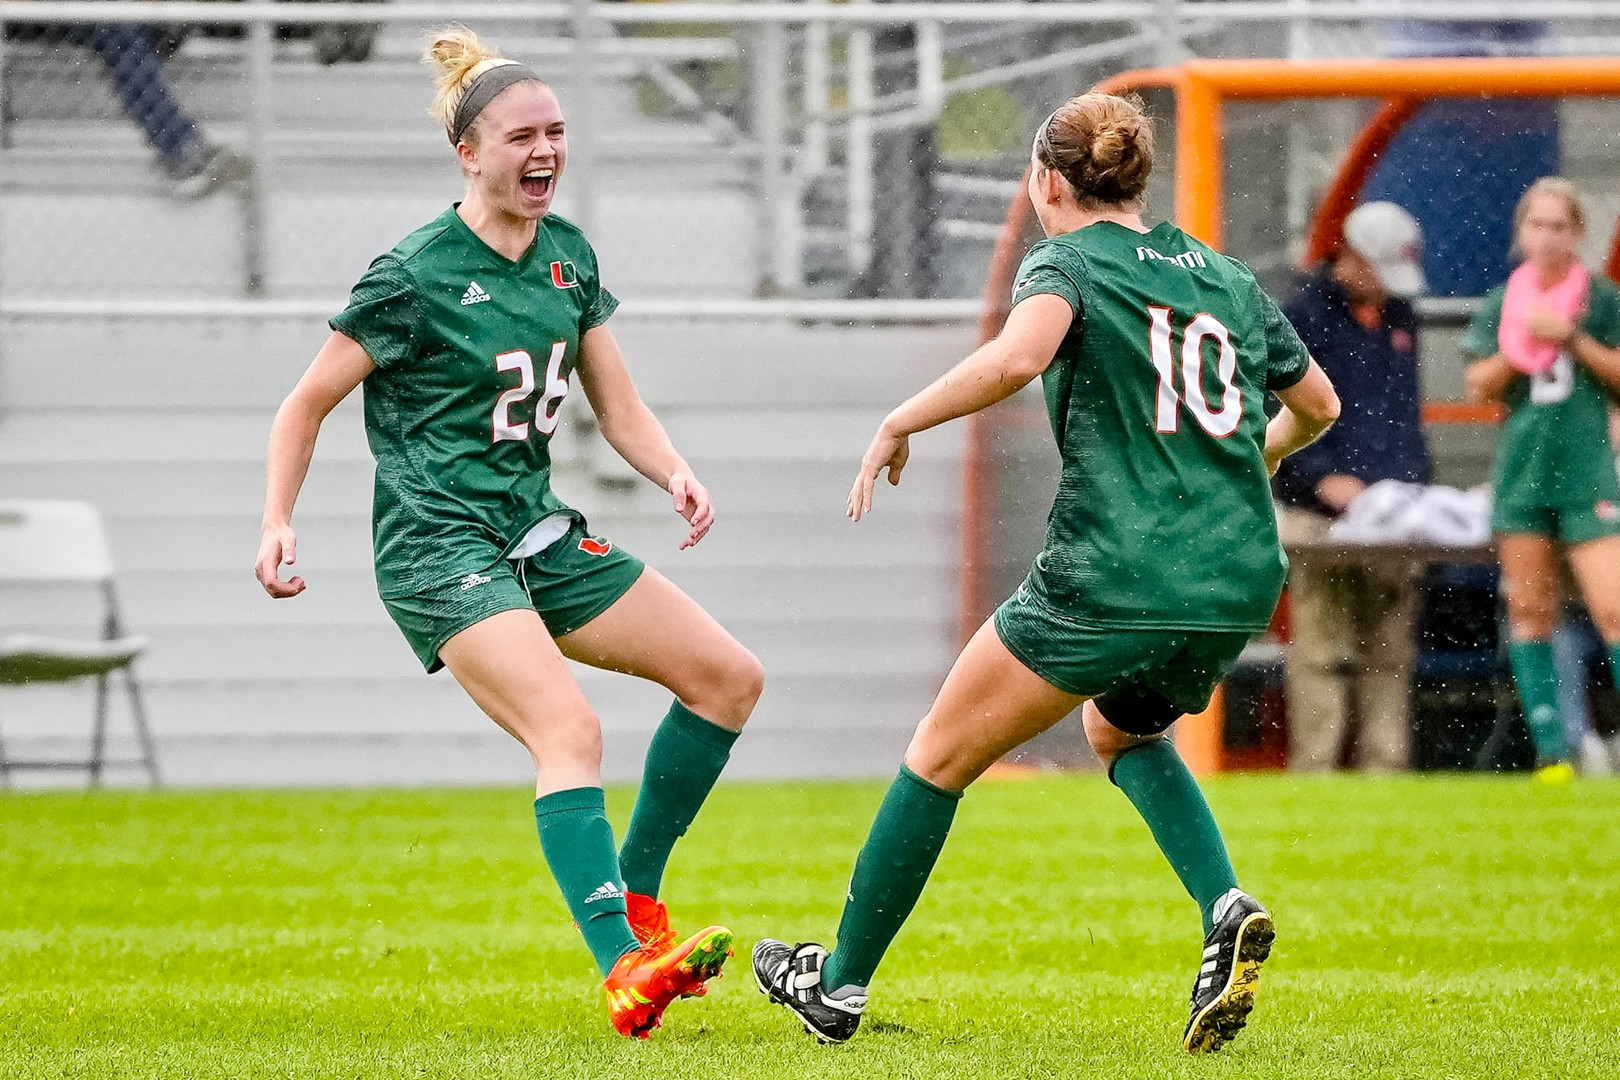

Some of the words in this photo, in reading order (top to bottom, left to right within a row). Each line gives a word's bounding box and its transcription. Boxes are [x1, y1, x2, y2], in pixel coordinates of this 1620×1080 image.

[550, 260, 579, 290] U
[460, 293, 491, 305] adidas
[1147, 305, 1244, 439] 10
[492, 340, 569, 443] 26
[460, 576, 492, 590] adidas
